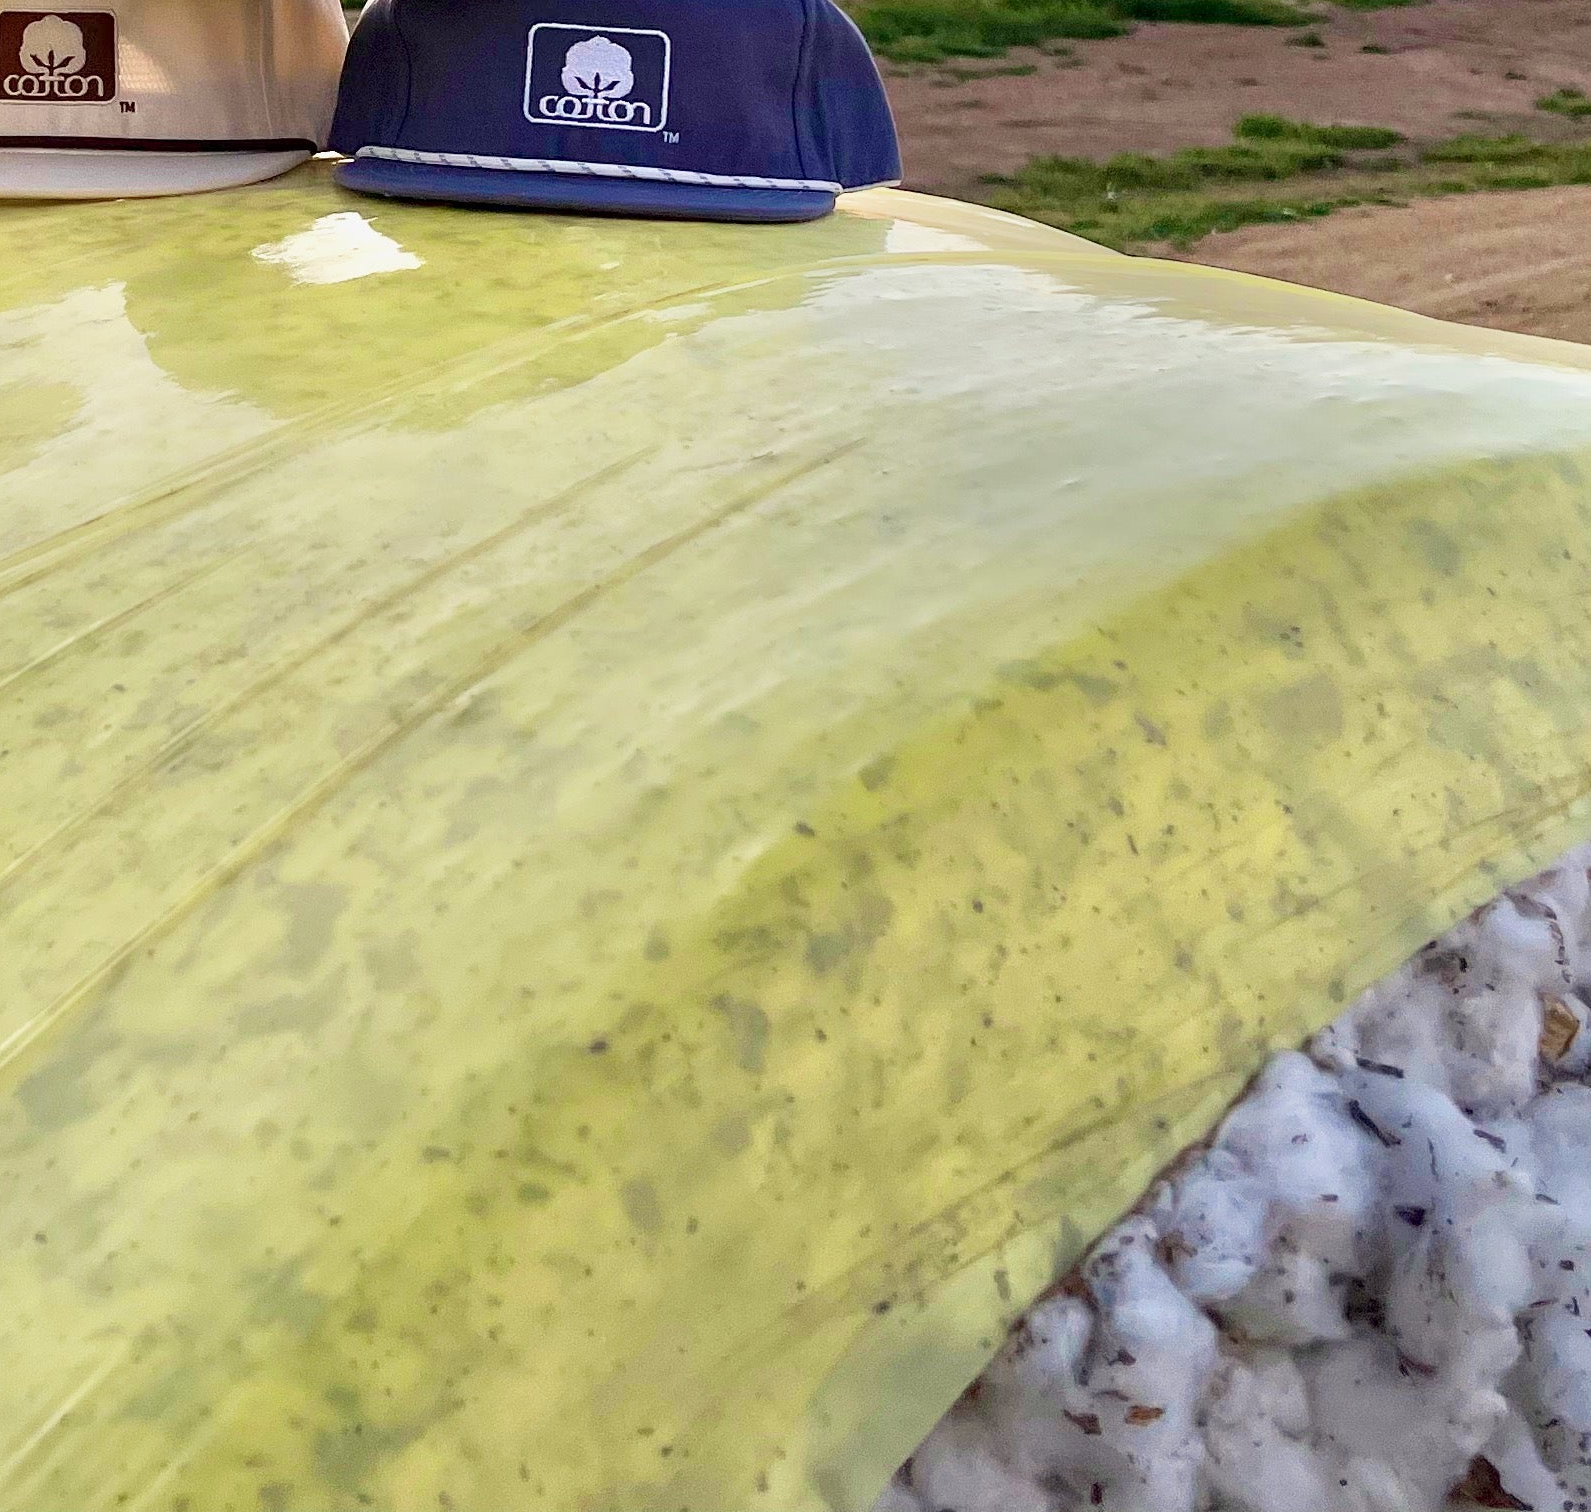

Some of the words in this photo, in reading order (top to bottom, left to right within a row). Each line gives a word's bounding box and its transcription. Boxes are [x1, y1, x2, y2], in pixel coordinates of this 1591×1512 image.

[3, 73, 104, 97] cotton
[119, 101, 136, 113] TM
[539, 95, 651, 125] cotton
[662, 130, 680, 144] TM
